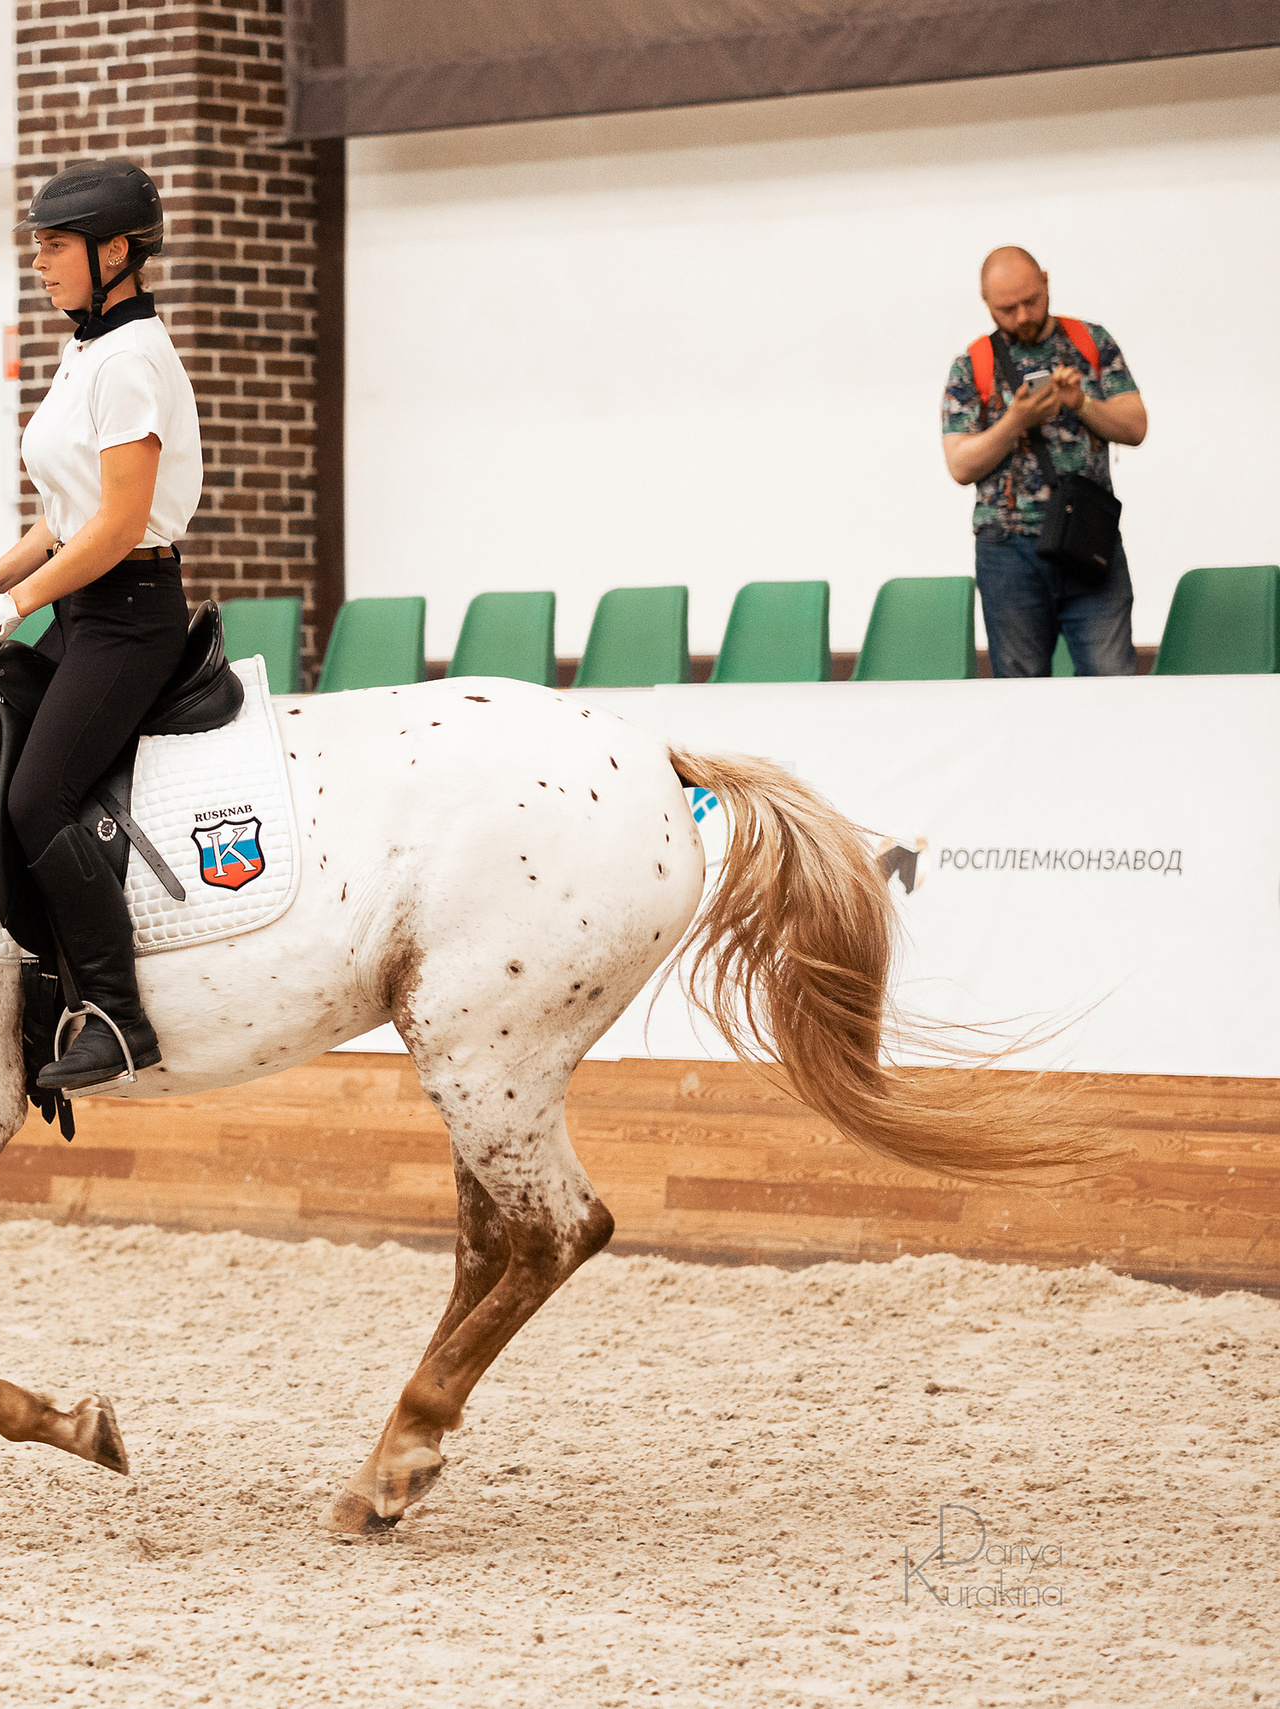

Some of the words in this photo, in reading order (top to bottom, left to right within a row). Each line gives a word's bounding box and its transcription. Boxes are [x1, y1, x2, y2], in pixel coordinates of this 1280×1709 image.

[194, 804, 253, 823] RUSKNAB
[207, 827, 257, 878] K
[939, 847, 1183, 876] РОСПЛЕМКОНЗАВОД
